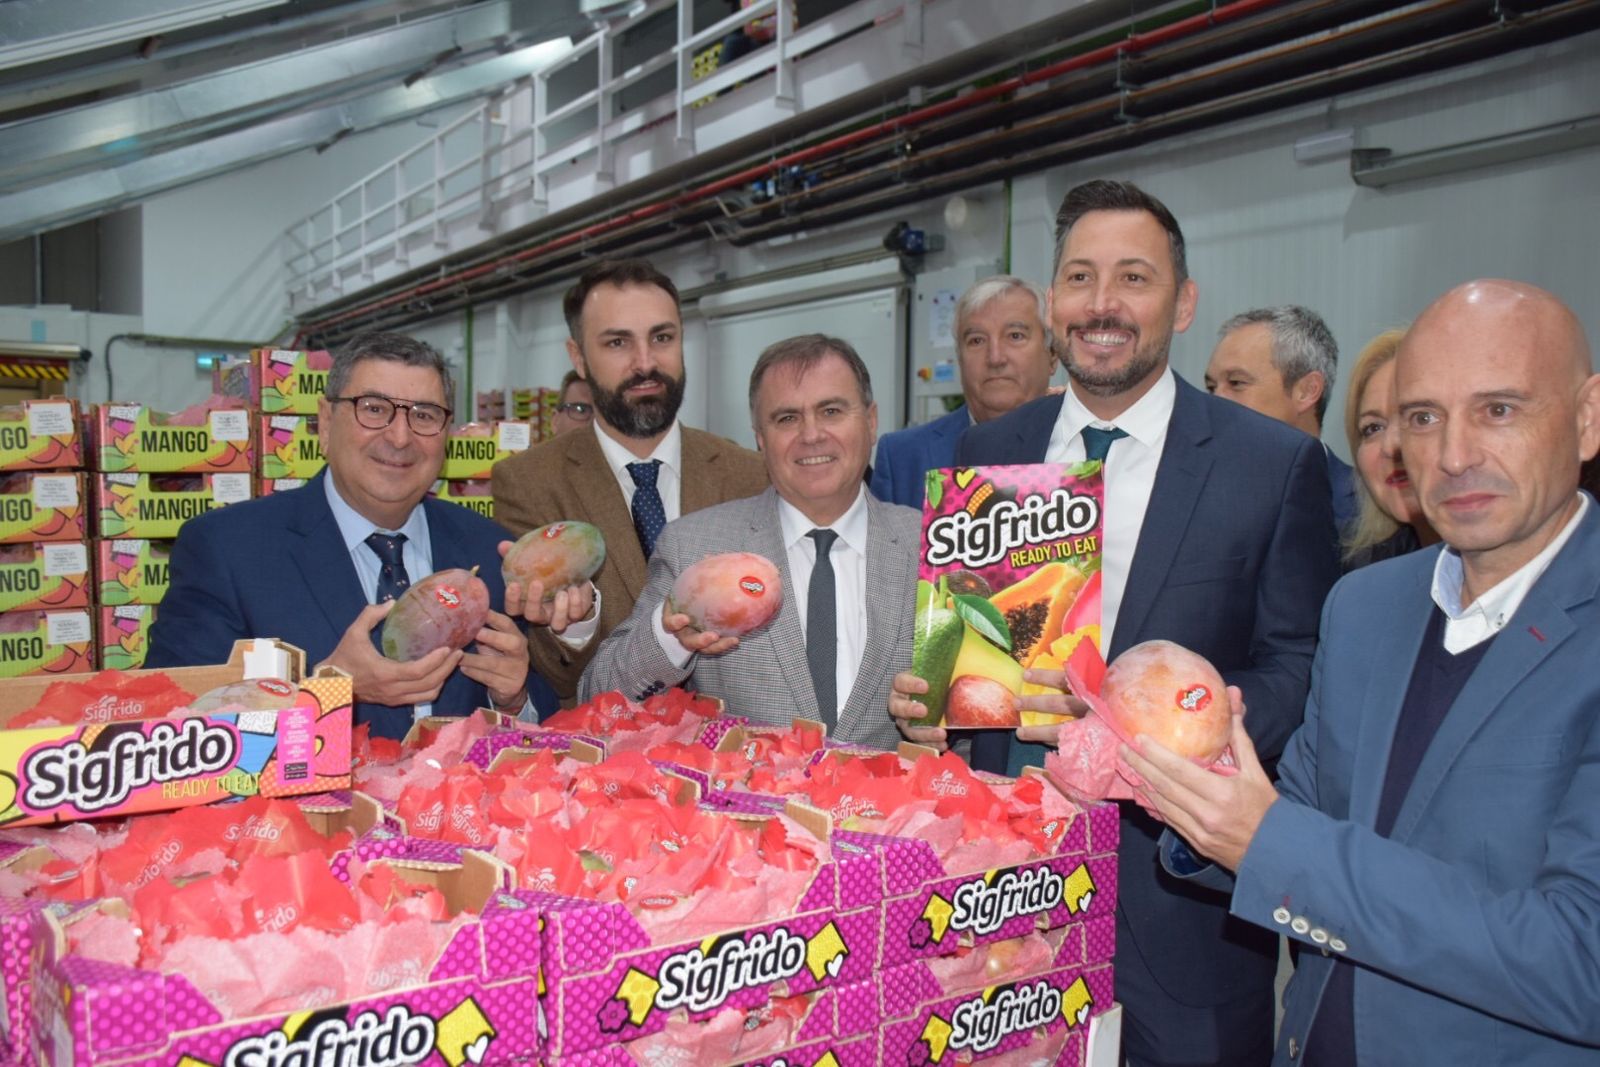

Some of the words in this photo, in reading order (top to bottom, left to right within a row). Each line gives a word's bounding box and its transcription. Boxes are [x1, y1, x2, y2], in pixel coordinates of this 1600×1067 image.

[299, 373, 330, 395] MA
[141, 430, 208, 453] MANGO
[930, 493, 1095, 564] Sigfrido
[1010, 545, 1051, 568] READY
[1054, 541, 1072, 558] TO
[1075, 536, 1096, 554] EAT
[0, 637, 43, 662] NGO
[84, 700, 143, 722] Sigfrido
[31, 722, 236, 807] Sigfrido
[162, 778, 210, 800] READY
[215, 775, 231, 793] TO
[952, 868, 1061, 931] Sigfrido
[660, 931, 802, 1008] Sigfrido
[950, 984, 1060, 1048] Sigfrido
